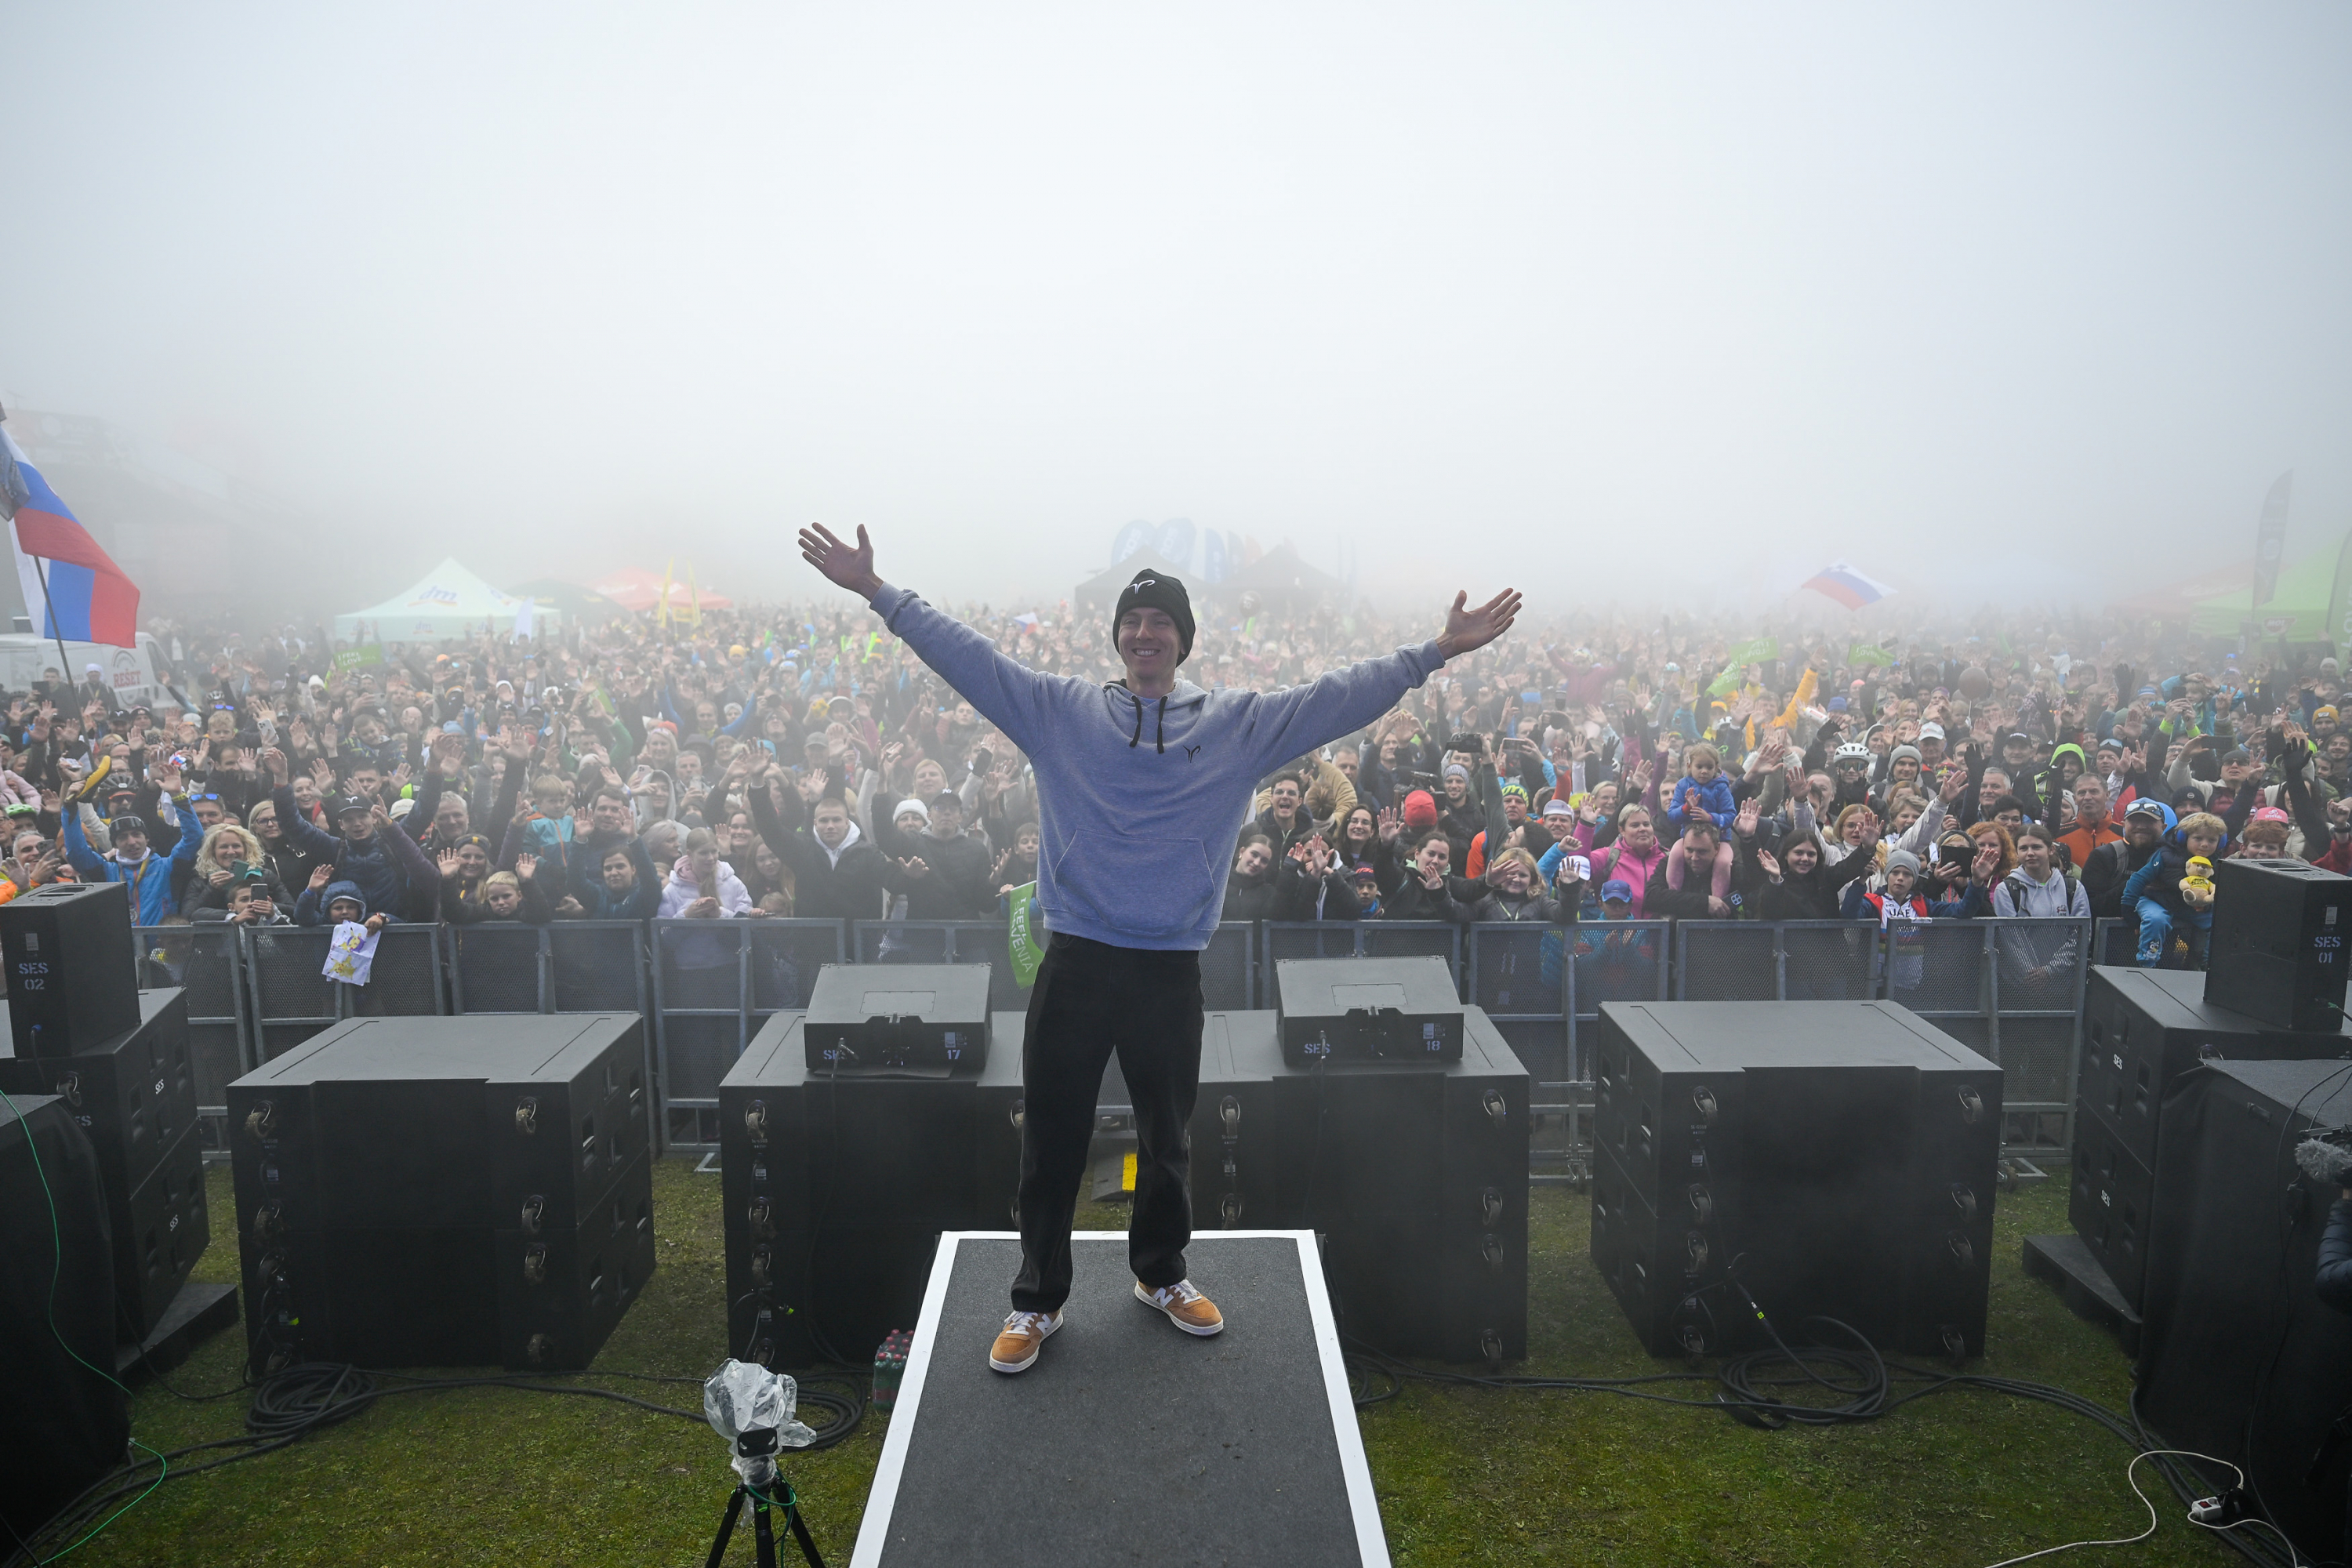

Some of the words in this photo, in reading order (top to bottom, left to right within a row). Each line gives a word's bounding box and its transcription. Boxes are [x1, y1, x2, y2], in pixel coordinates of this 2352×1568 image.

[419, 586, 458, 601] dm
[416, 620, 431, 630] dm
[113, 669, 142, 688] REŠET
[1889, 908, 1911, 918] UAE
[2314, 936, 2341, 948] SES
[2318, 952, 2333, 964] 01
[19, 962, 49, 975] SES
[24, 978, 45, 990] 02
[1304, 1043, 1330, 1054] SES
[1426, 1040, 1441, 1051] 18
[947, 1049, 961, 1060] 17
[2114, 1054, 2123, 1070] SES
